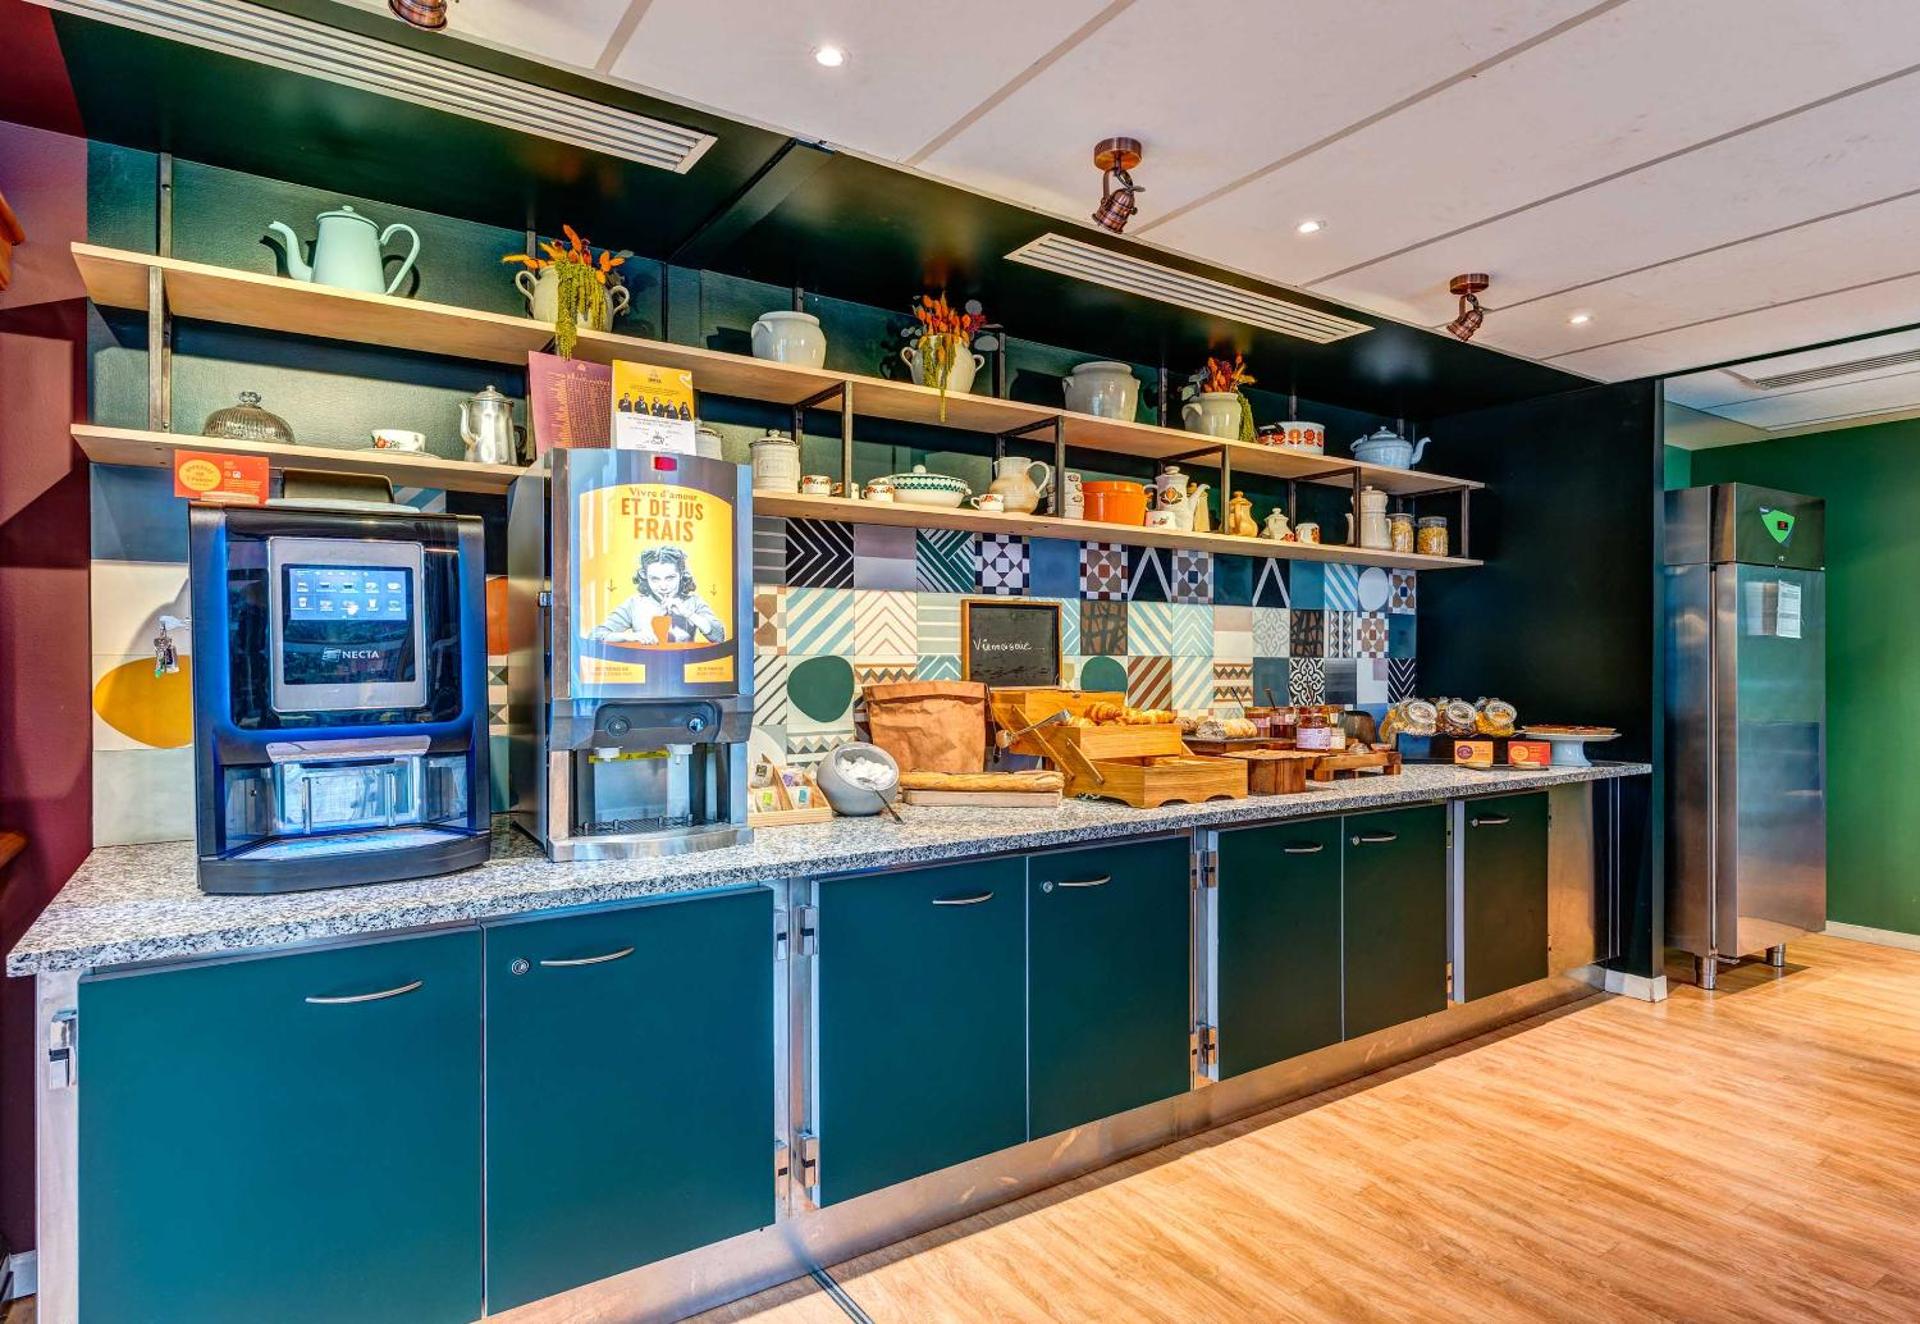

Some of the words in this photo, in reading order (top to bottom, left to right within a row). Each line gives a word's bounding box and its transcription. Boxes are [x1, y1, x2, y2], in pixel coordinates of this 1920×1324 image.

[629, 487, 657, 497] Vivre
[621, 497, 641, 515] ET
[649, 498, 671, 517] DE
[677, 501, 703, 521] JUS
[634, 517, 693, 542] FRAIS
[342, 650, 380, 659] NECTA
